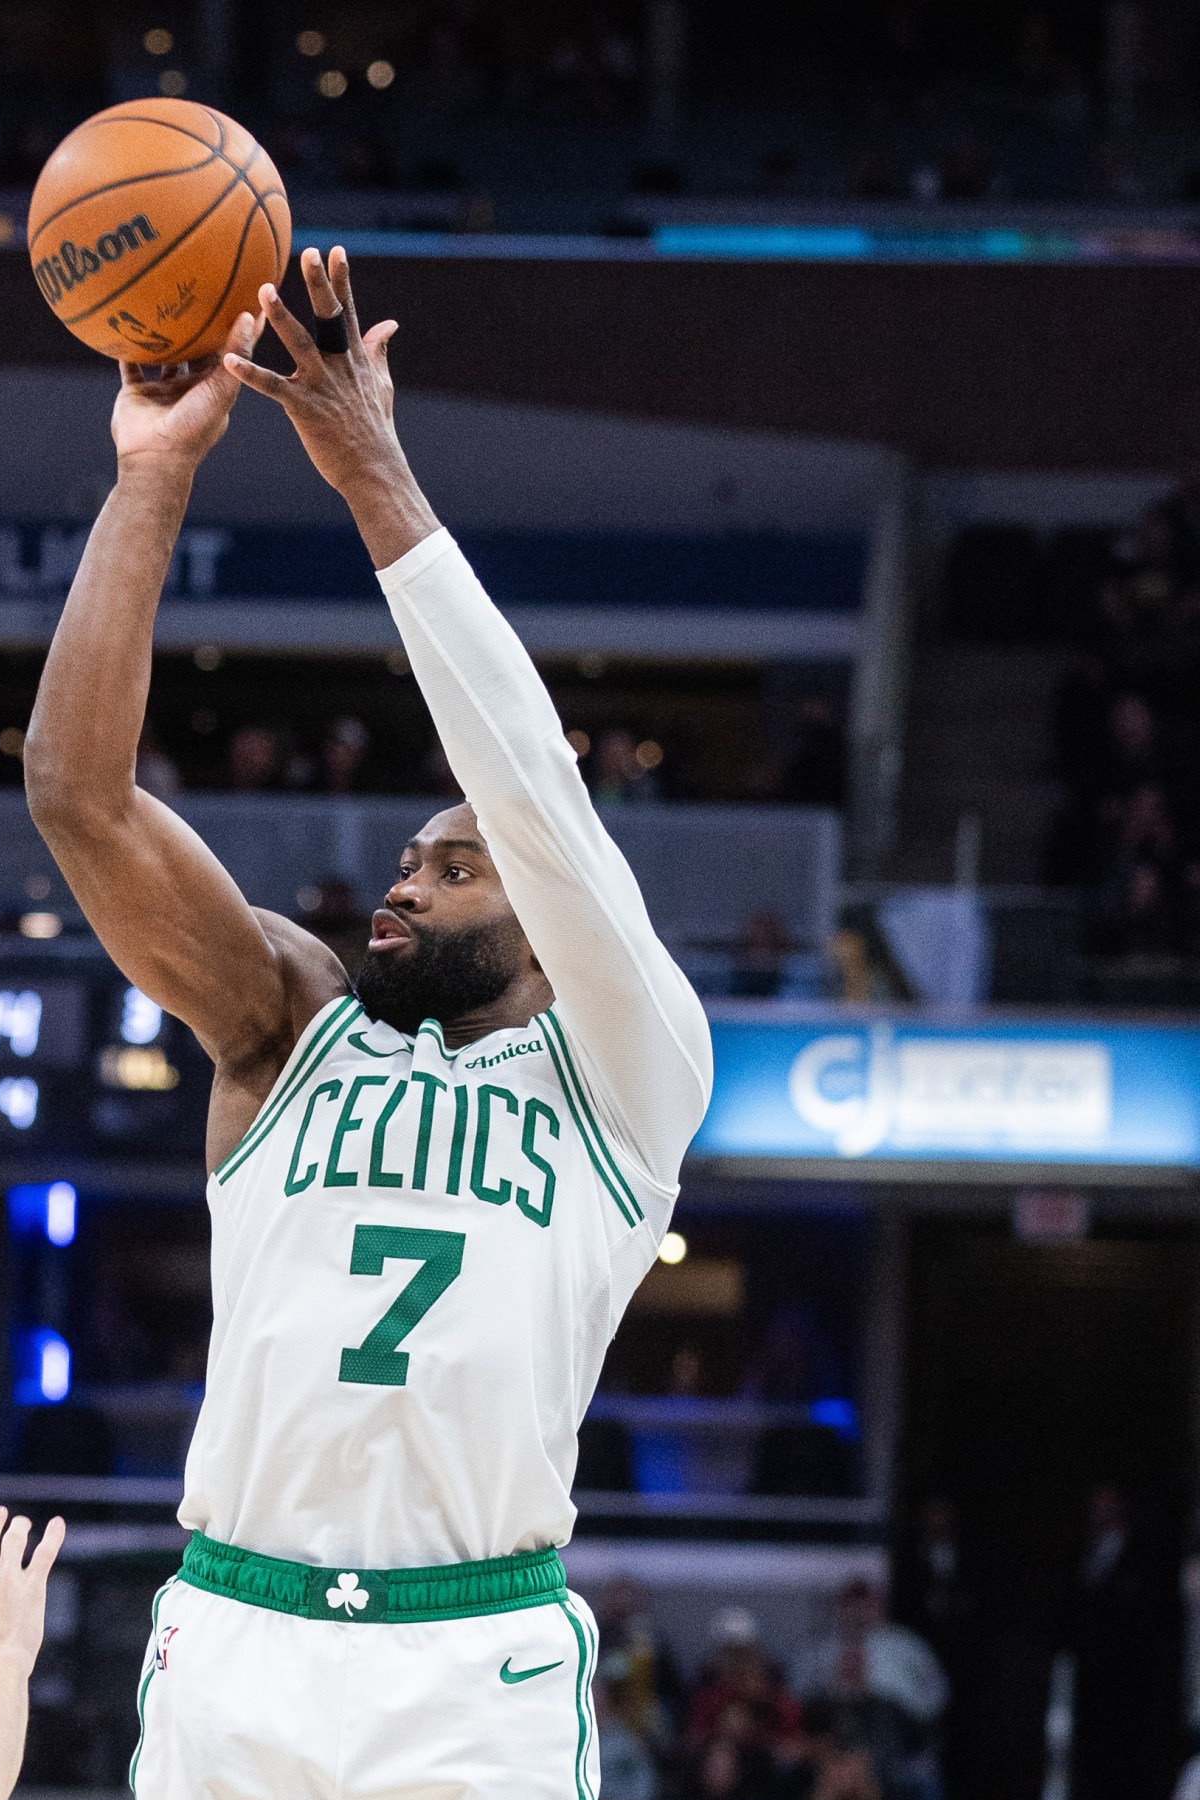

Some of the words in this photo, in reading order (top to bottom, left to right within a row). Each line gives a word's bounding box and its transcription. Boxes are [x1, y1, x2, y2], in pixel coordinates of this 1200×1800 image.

[465, 1040, 544, 1069] Amica
[284, 1070, 560, 1228] CELTICS
[338, 1224, 467, 1386] 7
